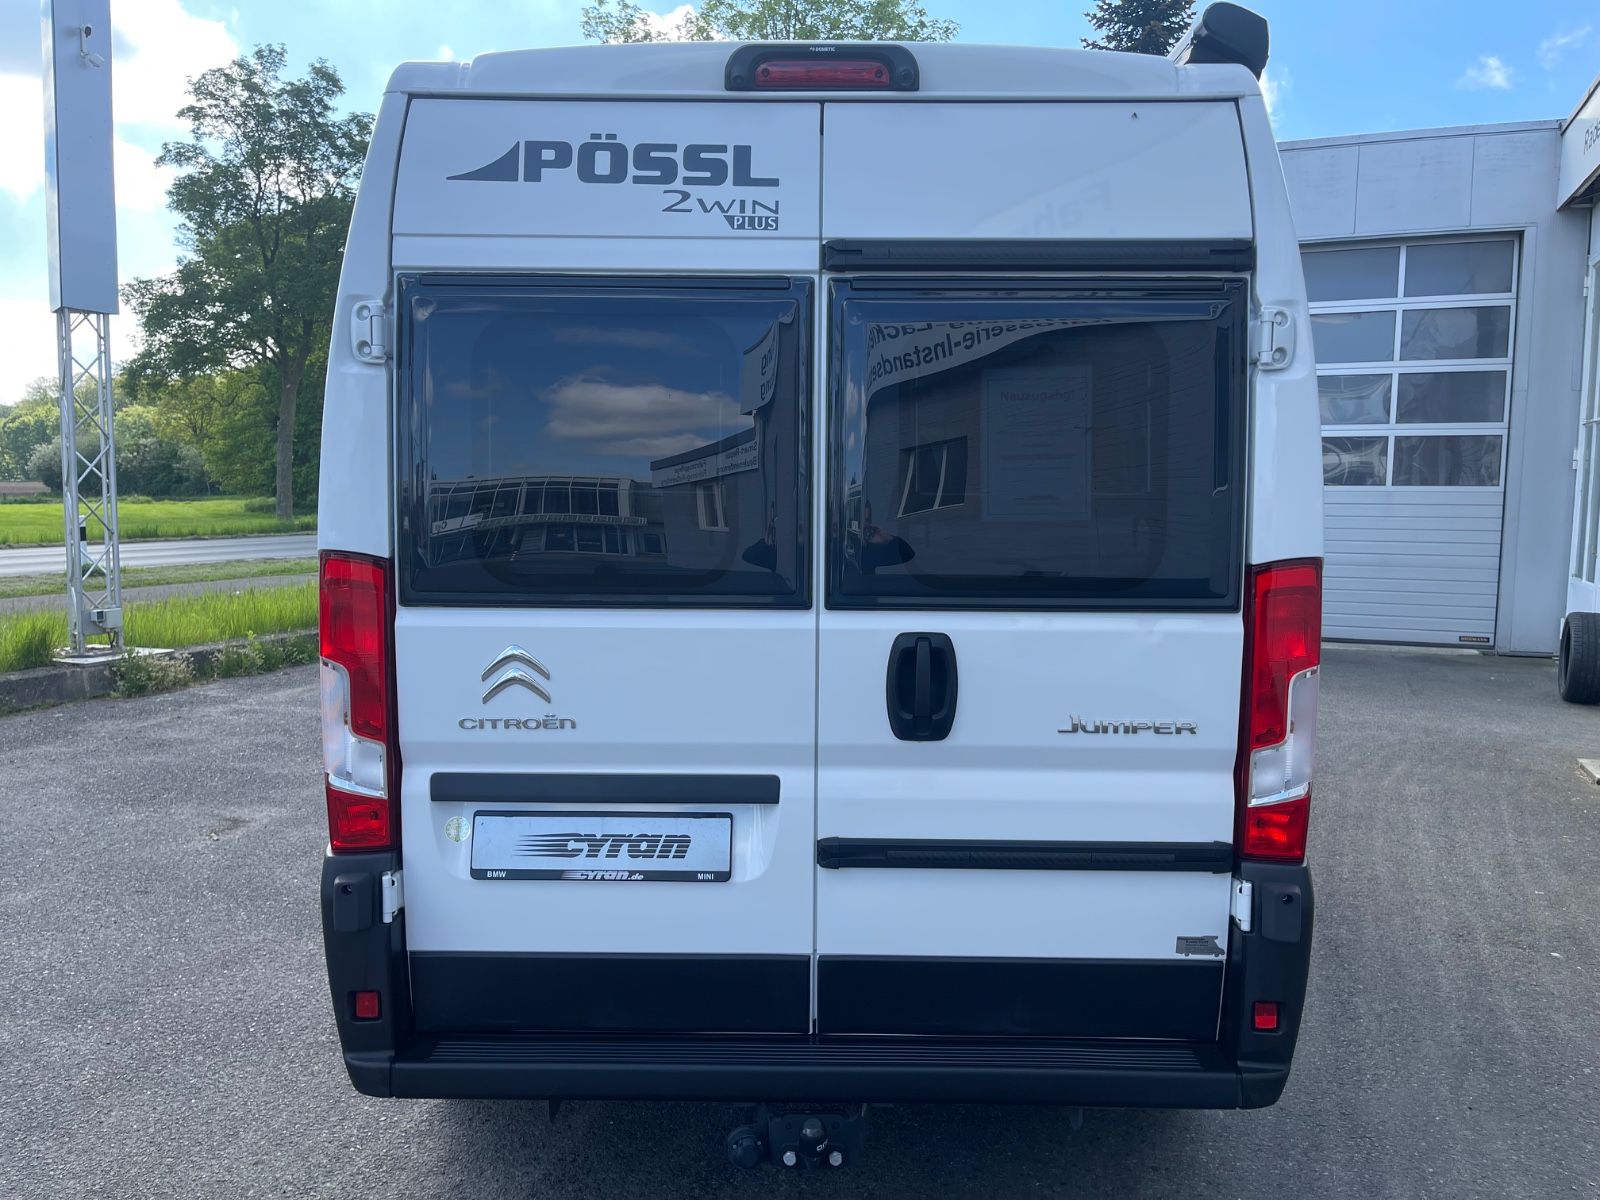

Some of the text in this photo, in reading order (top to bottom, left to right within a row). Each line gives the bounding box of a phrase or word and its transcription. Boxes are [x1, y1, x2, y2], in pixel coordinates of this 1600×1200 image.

[523, 133, 780, 187] PÖSSL
[732, 215, 779, 231] PLUS
[486, 870, 507, 878] BMW
[697, 872, 715, 881] MINI
